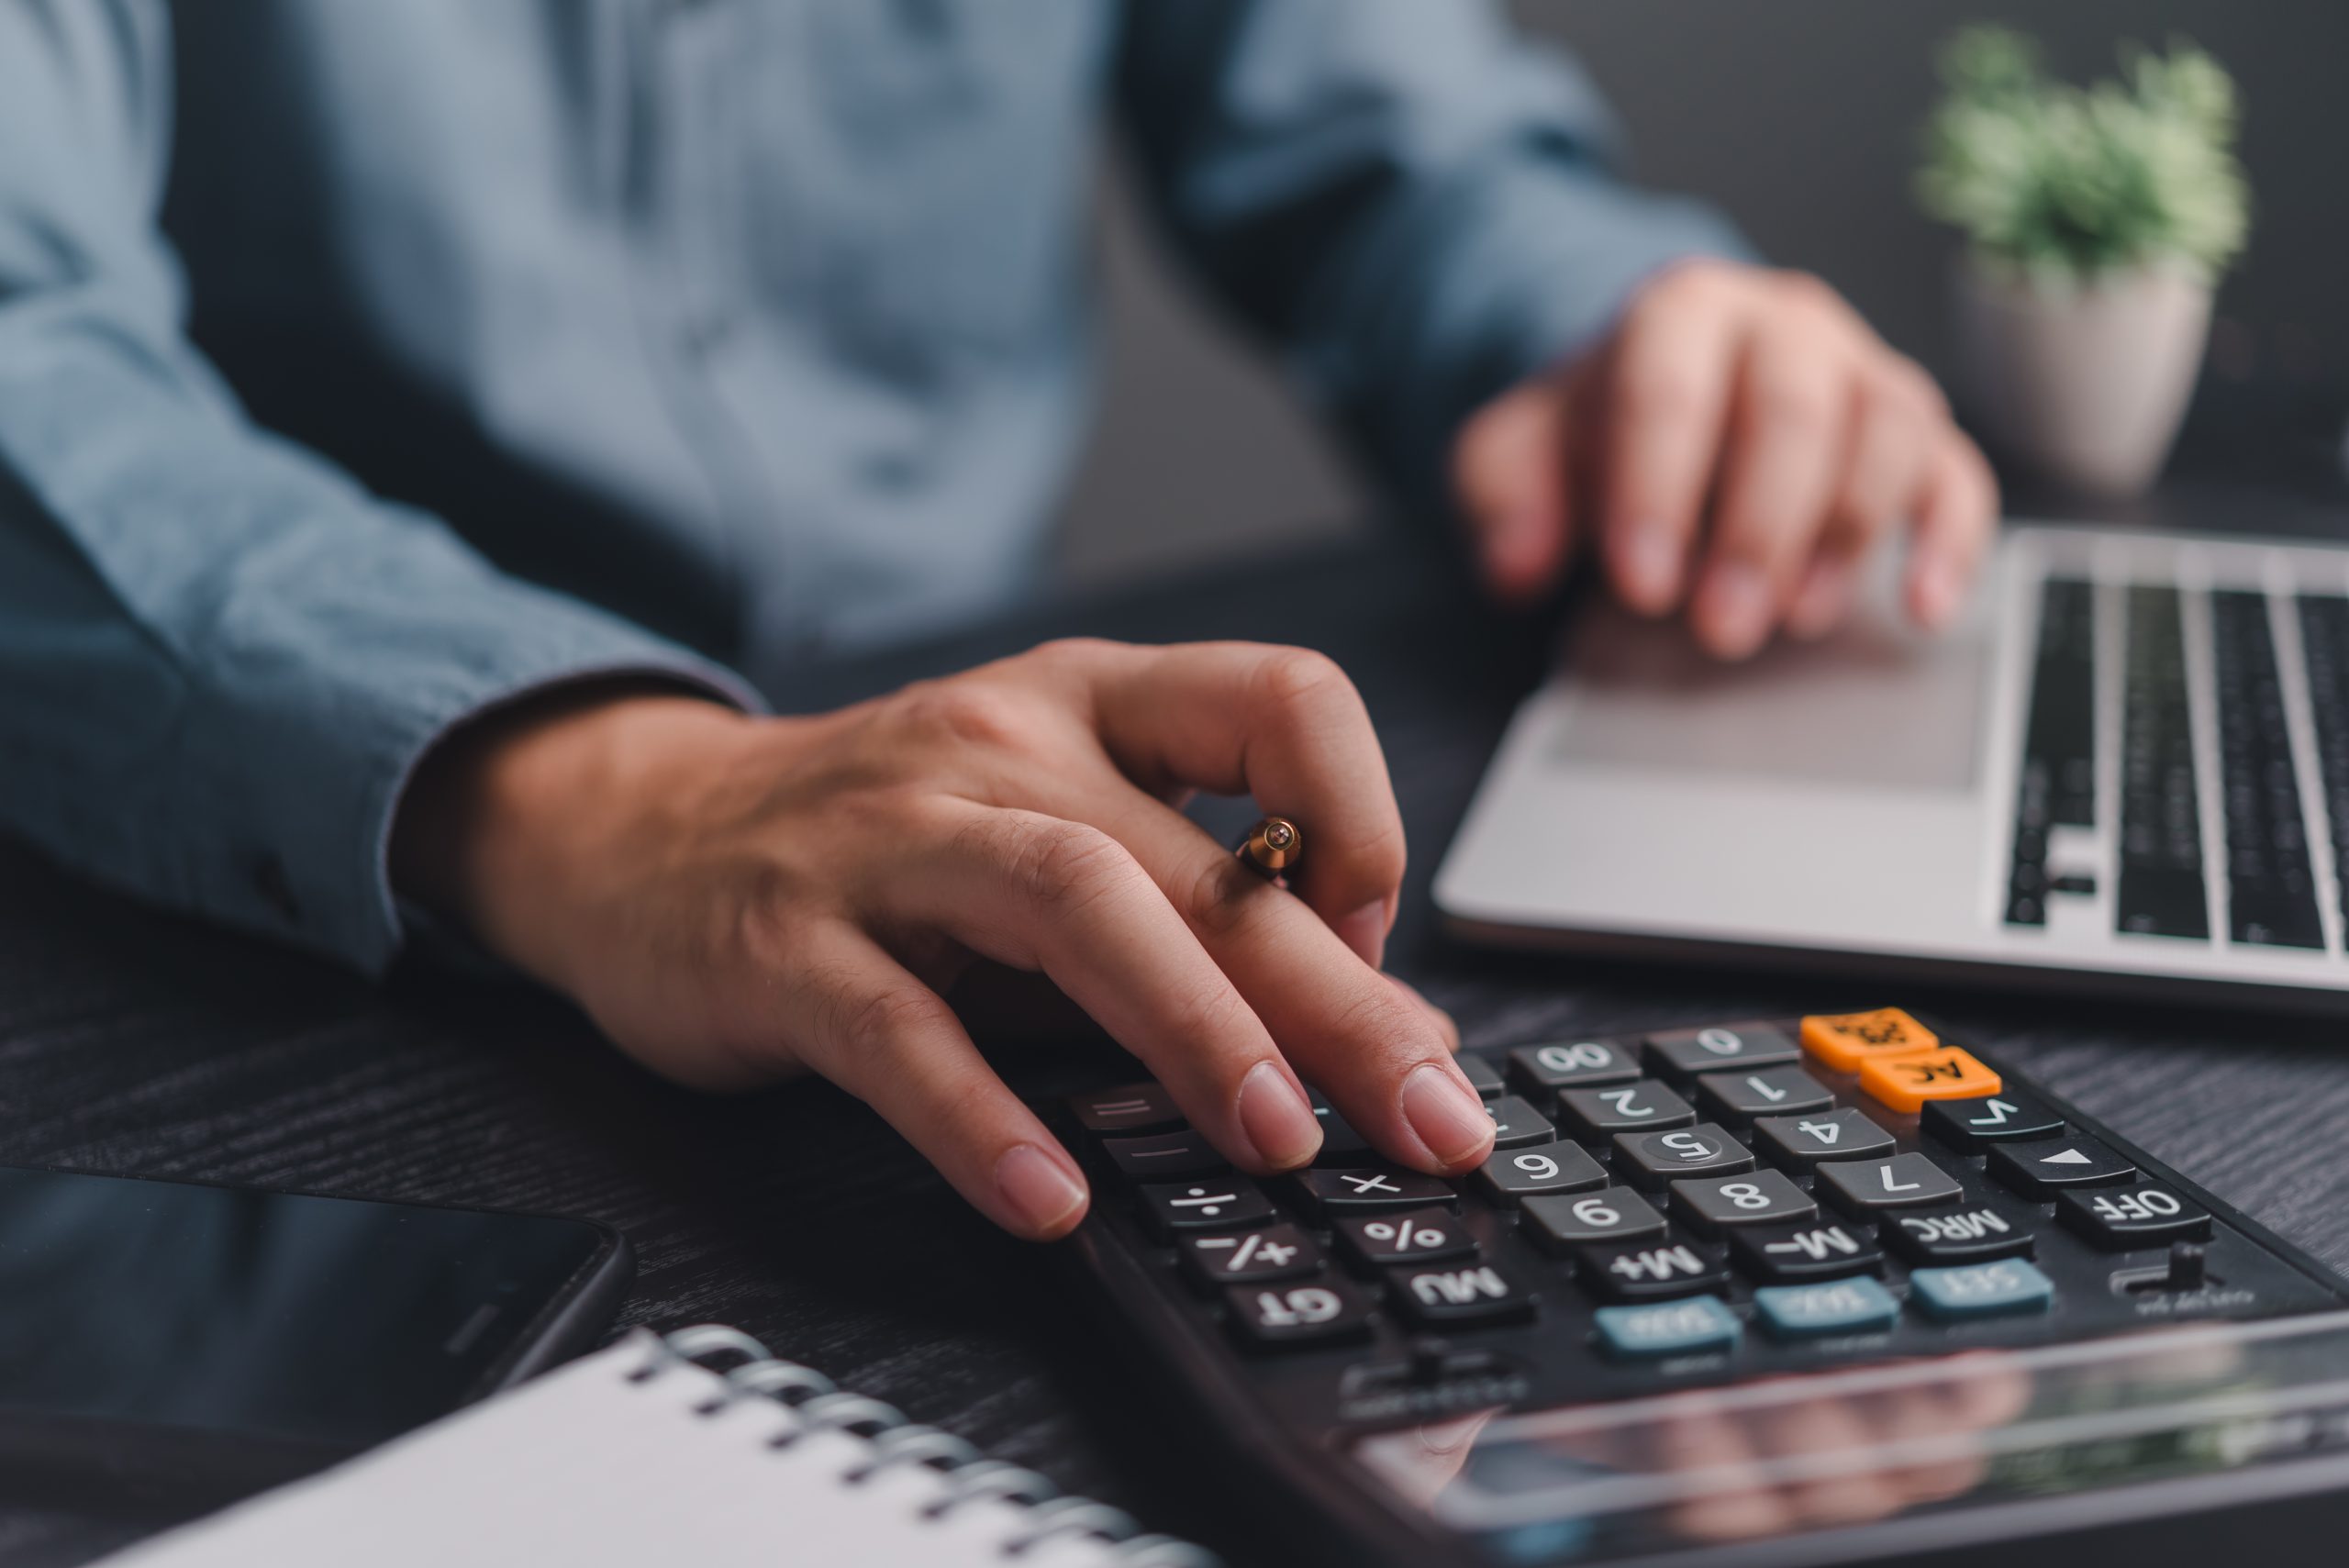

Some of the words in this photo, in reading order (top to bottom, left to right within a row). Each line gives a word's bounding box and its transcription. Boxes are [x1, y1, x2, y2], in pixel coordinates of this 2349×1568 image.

[1698, 1029, 1742, 1055] 0
[1537, 1042, 1612, 1072] 00
[1747, 1076, 1787, 1101] 1
[1598, 1089, 1654, 1117] 2
[1661, 1132, 1711, 1158] 5
[1798, 1120, 1840, 1144] 4
[1514, 1154, 1559, 1180] 6
[1880, 1165, 1920, 1192] 7
[1719, 1183, 1771, 1209] 8
[2092, 1190, 2181, 1221] OFF
[1572, 1198, 1620, 1227] 9
[1899, 1208, 2010, 1242] MRC
[1364, 1219, 1446, 1251] %
[1609, 1245, 1705, 1280] M+
[1410, 1266, 1508, 1305] MU
[1257, 1288, 1342, 1326] GT
